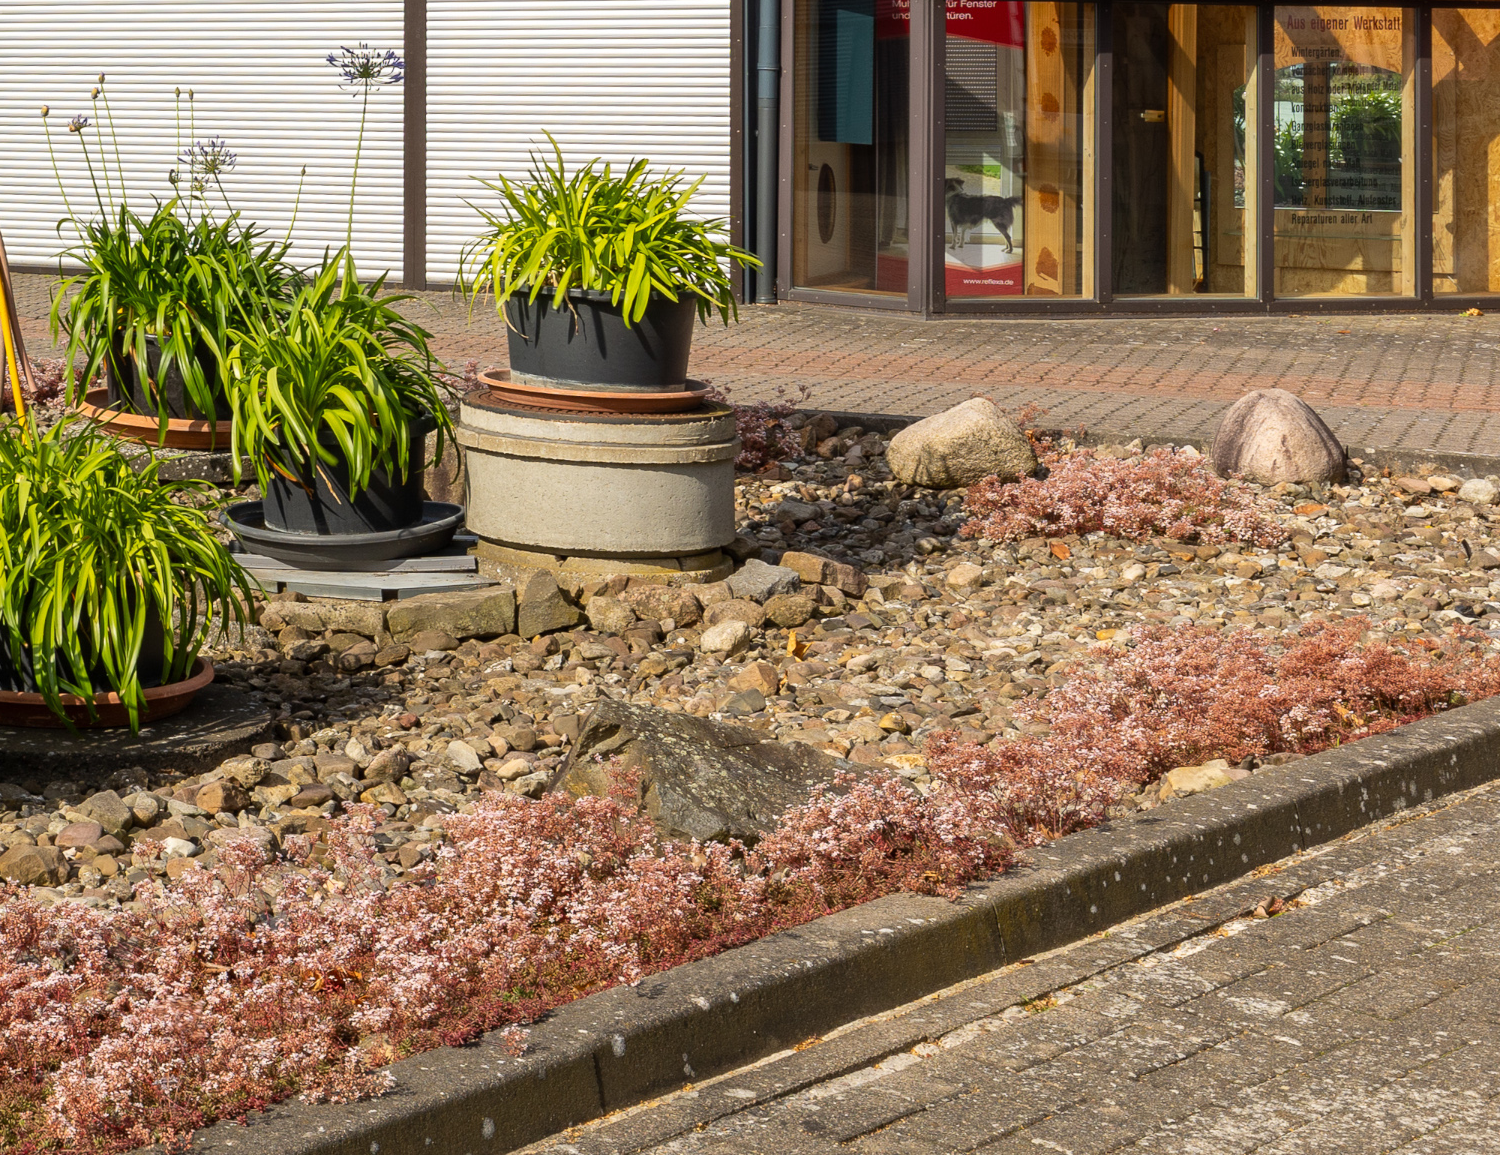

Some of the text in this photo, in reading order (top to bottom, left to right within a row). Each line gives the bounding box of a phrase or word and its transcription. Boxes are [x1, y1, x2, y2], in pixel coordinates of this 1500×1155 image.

[960, 0, 997, 8] Fenster
[1287, 15, 1401, 32] Aus eigener Werkstatt
[1292, 85, 1304, 94] aus
[1308, 83, 1325, 94] Holz
[1292, 213, 1373, 225] Reparaturen aller Art
